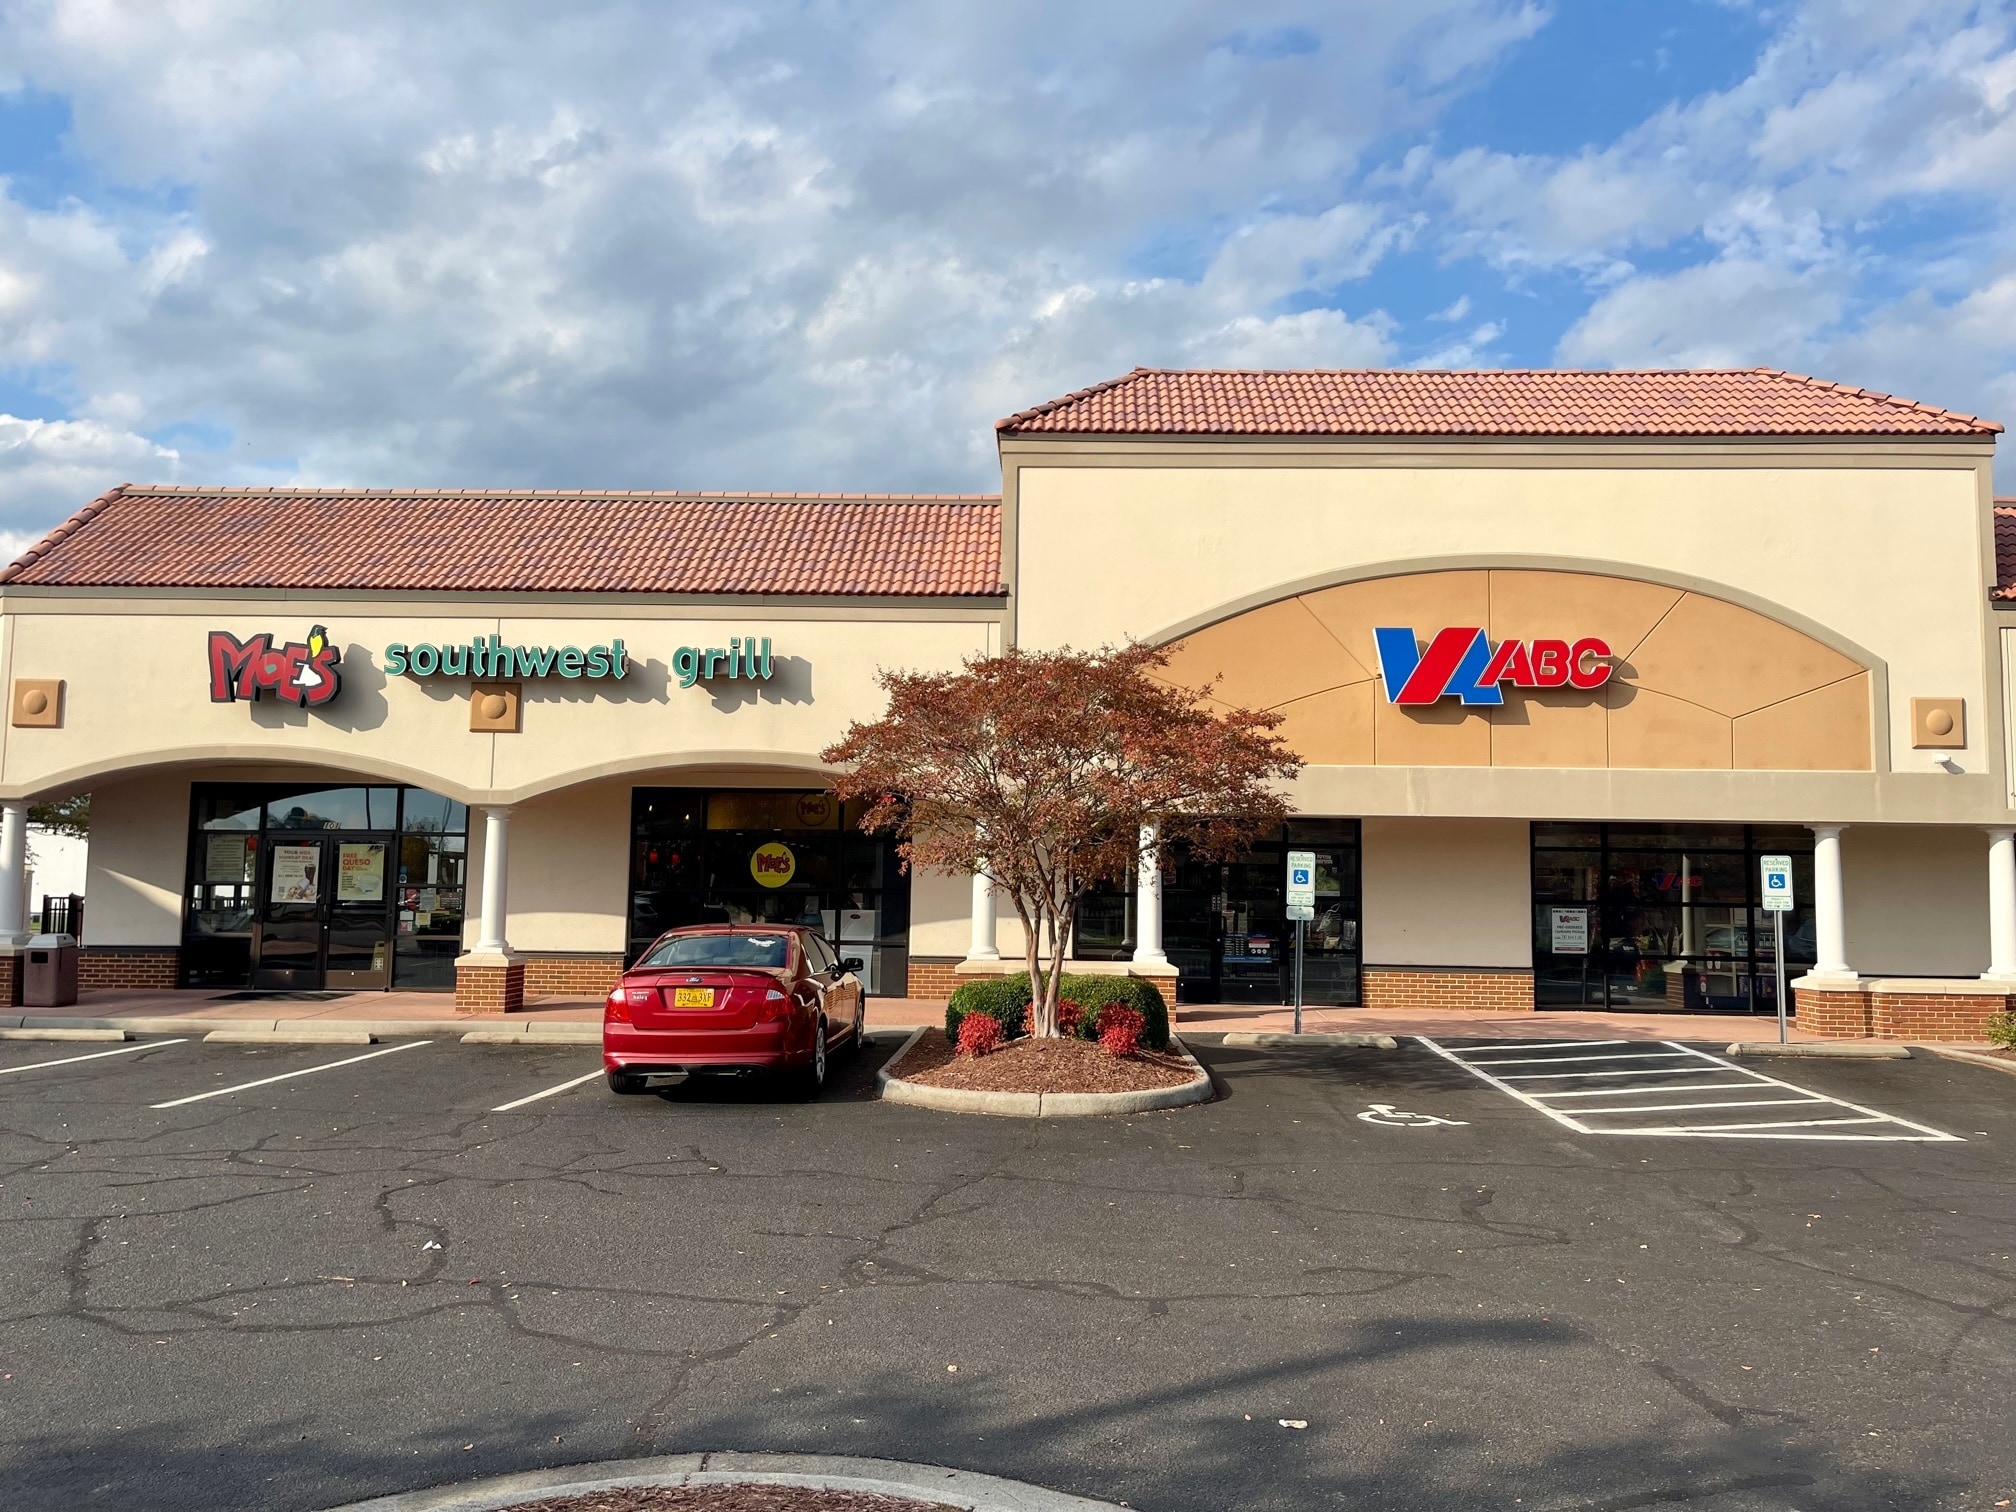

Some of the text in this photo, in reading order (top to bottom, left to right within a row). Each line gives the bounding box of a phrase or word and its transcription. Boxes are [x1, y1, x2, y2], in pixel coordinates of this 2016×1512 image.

[384, 634, 774, 688] southwest grill
[1474, 638, 1613, 689] ABC
[342, 858, 371, 866] QUESO
[678, 993, 691, 1002] 332
